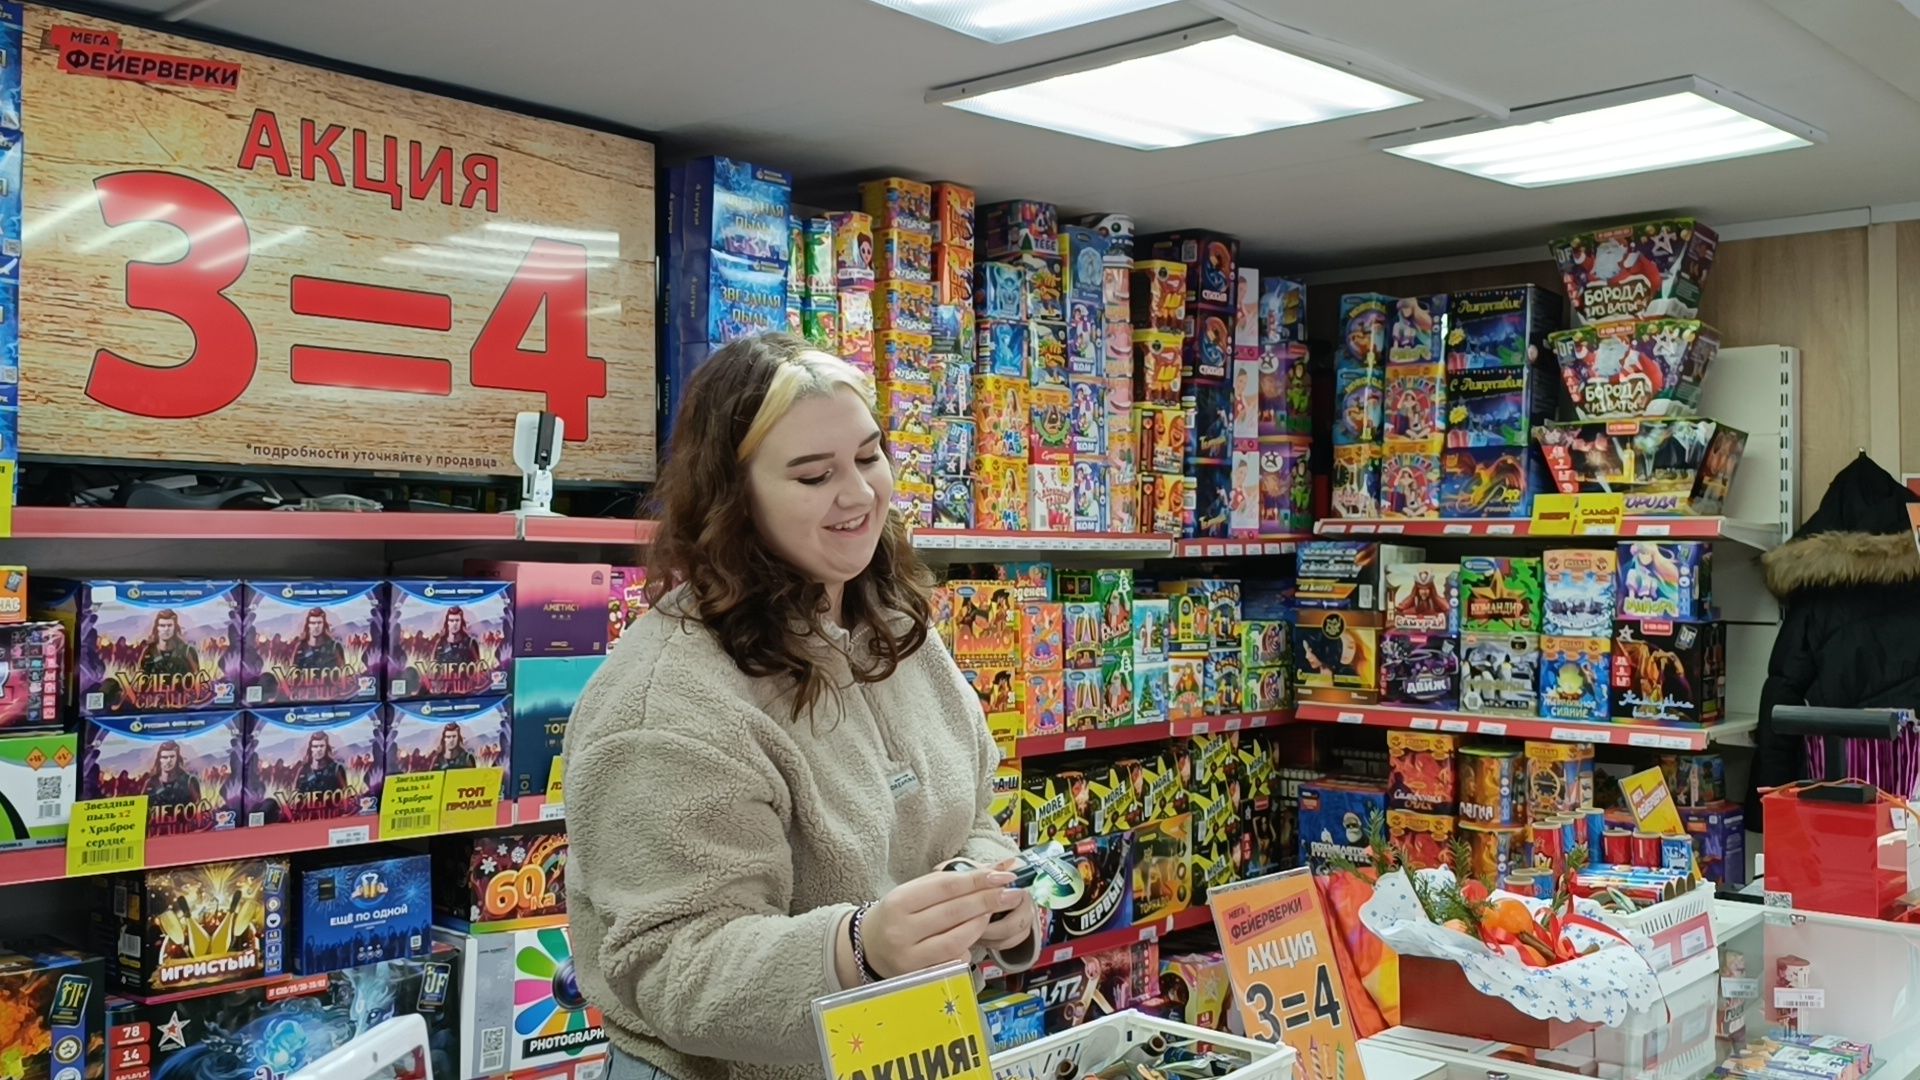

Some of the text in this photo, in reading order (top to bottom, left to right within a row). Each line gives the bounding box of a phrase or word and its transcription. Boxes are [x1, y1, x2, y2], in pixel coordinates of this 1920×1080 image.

[70, 31, 110, 46] МЕГА
[65, 49, 239, 87] ФЕЙЕРВЕРКИ
[237, 108, 499, 213] АКЦИЯ
[720, 285, 782, 309] ЗВЕЗДНАЯ
[1583, 281, 1645, 306] БОРОДА
[85, 170, 607, 442] 3=4
[1607, 302, 1637, 316] ВАТЫ
[1584, 380, 1645, 401] БОРОДА
[353, 449, 423, 464] уточняйте
[425, 453, 434, 467] у
[436, 454, 497, 469] продавца
[1060, 467, 1069, 477] 16
[1581, 507, 1620, 516] САМЫЙ
[1470, 602, 1524, 617] КОМАНДИР
[1396, 612, 1446, 631] САМУРАЙ
[1406, 680, 1447, 694] ДВИЖ
[395, 774, 435, 784] Звездная
[396, 785, 419, 793] пыль
[457, 786, 486, 799] ТОП
[1104, 784, 1125, 804] MORE
[84, 800, 135, 811] Звездная
[398, 793, 434, 804] Храброе
[445, 798, 493, 812] ПРОДАЖ
[394, 806, 426, 816] сердце
[1038, 799, 1064, 817] MORE
[86, 812, 117, 822] пыль
[89, 822, 136, 835] Храброе
[86, 837, 126, 848] сердце
[330, 903, 408, 927] ЕЩЁ ПО ОДНОЙ
[1228, 906, 1246, 920] МЕГА
[1230, 896, 1303, 939] ФЕЙЕРВЕРКИ
[1247, 930, 1318, 974] АКЦИЯ
[161, 950, 257, 983] ИГРИСТЫЙ
[1246, 963, 1341, 1045] 3=4
[122, 1025, 140, 1037] 78
[529, 1028, 605, 1052] PHOTOGRAPH
[122, 1049, 140, 1061] 14
